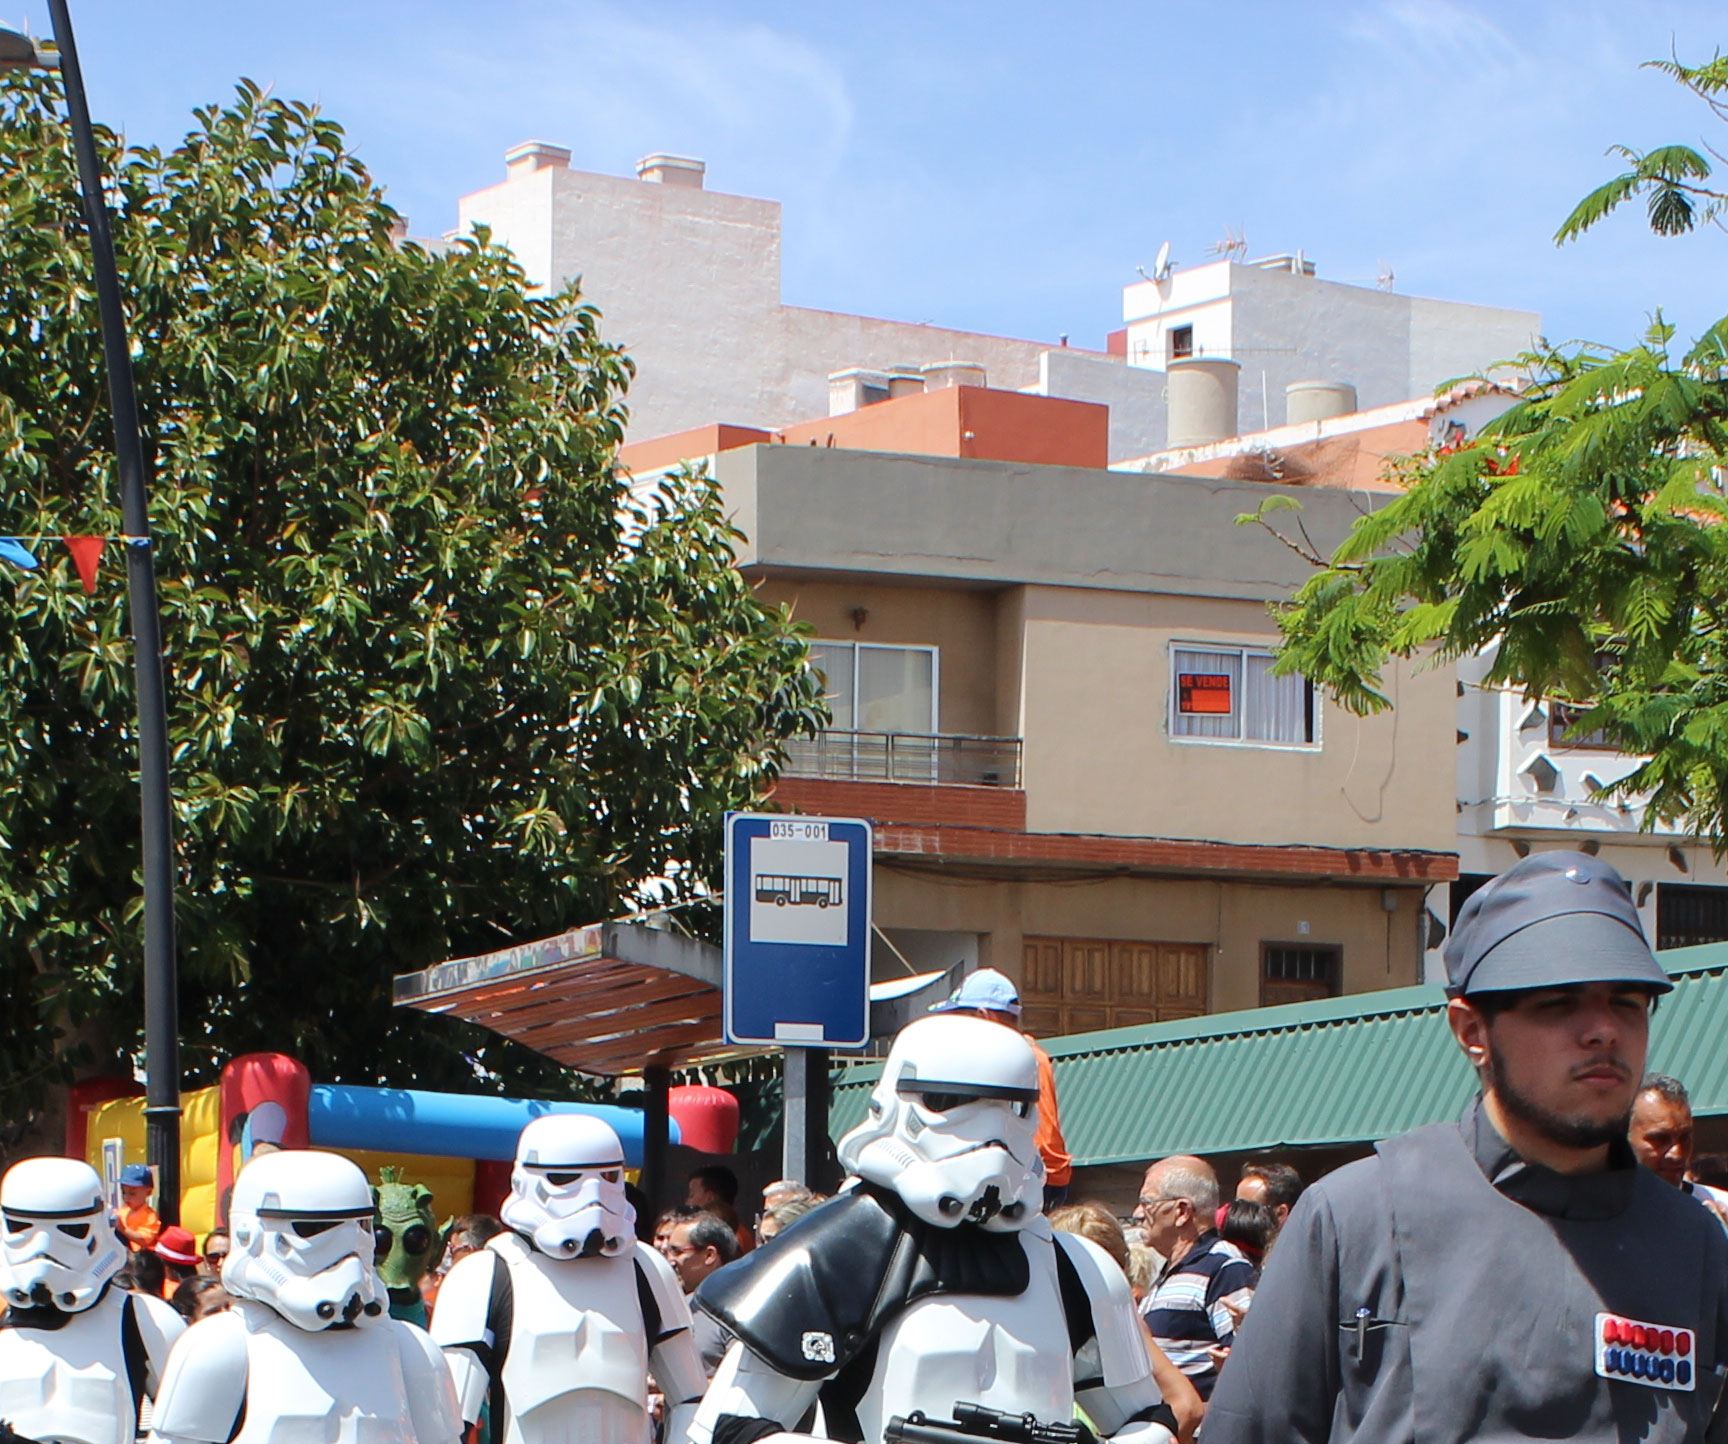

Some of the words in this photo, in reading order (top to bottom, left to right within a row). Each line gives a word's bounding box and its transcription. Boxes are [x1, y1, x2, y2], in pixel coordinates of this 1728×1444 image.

[1180, 675, 1193, 687] SE
[1196, 676, 1229, 688] VENDE
[773, 823, 826, 839] 035-001
